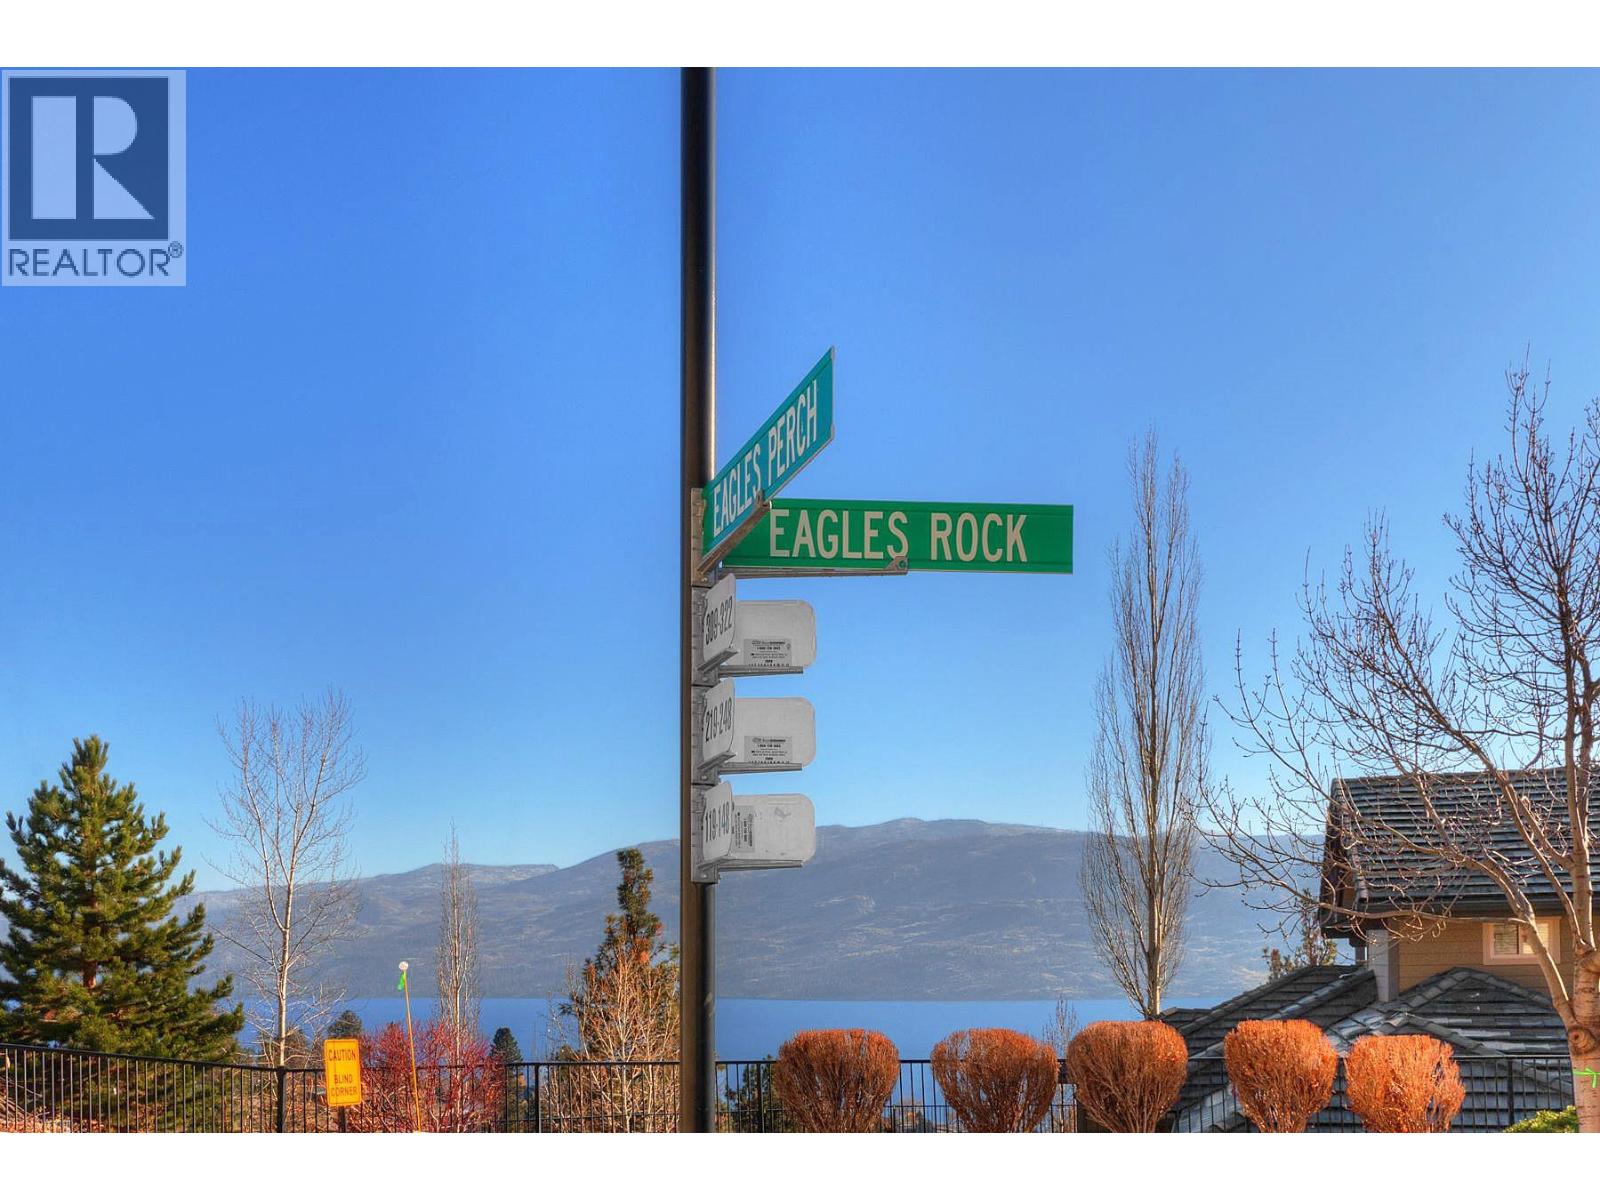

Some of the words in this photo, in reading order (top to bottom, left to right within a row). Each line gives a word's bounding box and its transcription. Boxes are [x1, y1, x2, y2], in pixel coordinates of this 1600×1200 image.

[713, 443, 761, 538] EAGLES
[767, 378, 818, 488] PERCH
[769, 508, 909, 560] EAGLES
[930, 511, 1028, 563] ROCK
[705, 697, 732, 743] 219-248
[328, 1049, 356, 1061] CAUTION
[331, 1086, 357, 1096] CORNER
[333, 1074, 353, 1084] BLIND
